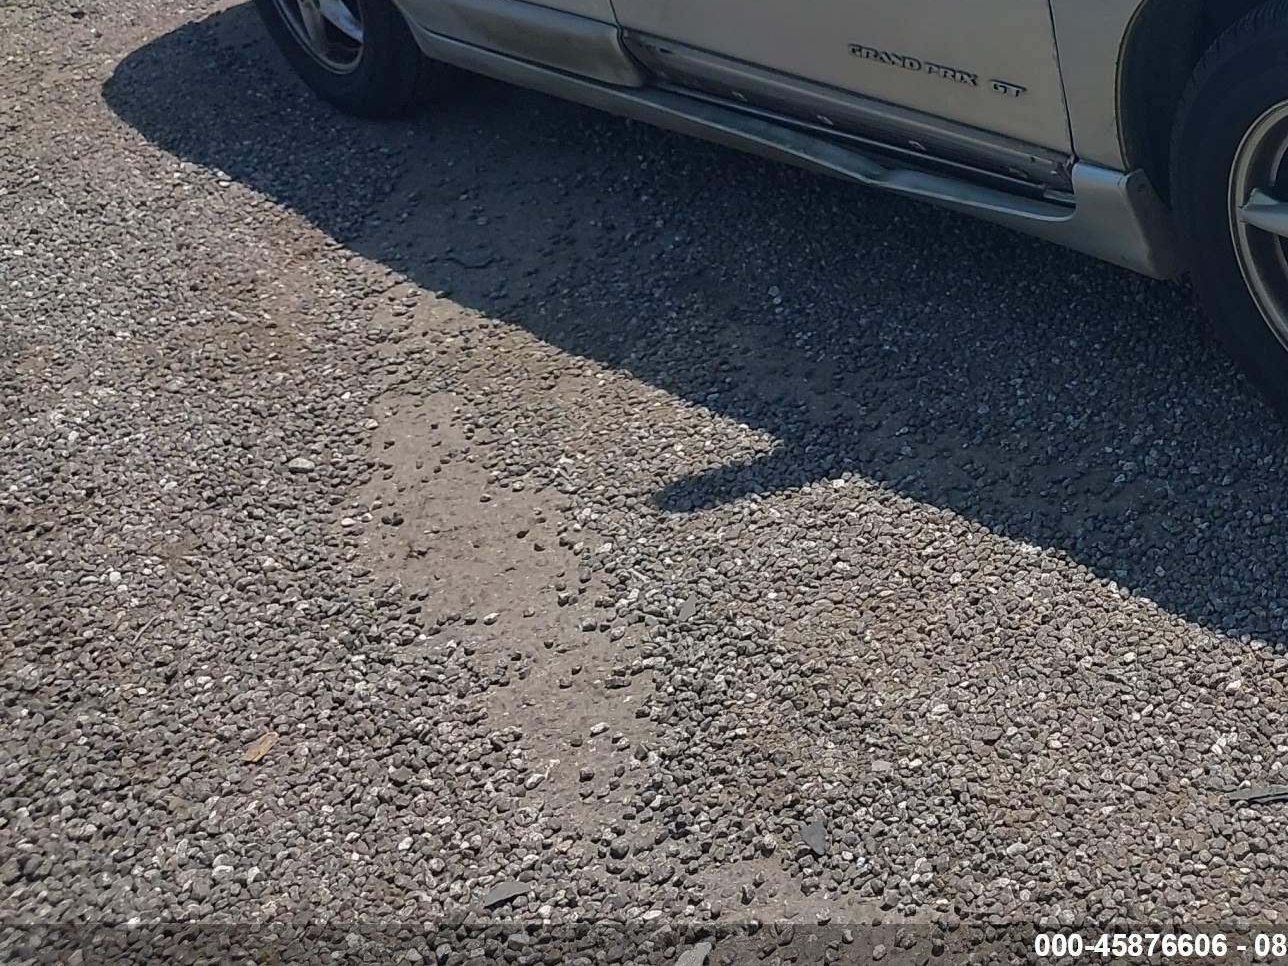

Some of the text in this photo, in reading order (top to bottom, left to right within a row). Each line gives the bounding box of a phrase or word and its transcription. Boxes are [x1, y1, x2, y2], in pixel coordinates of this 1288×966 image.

[848, 43, 1028, 98] GRAND PRIX GT
